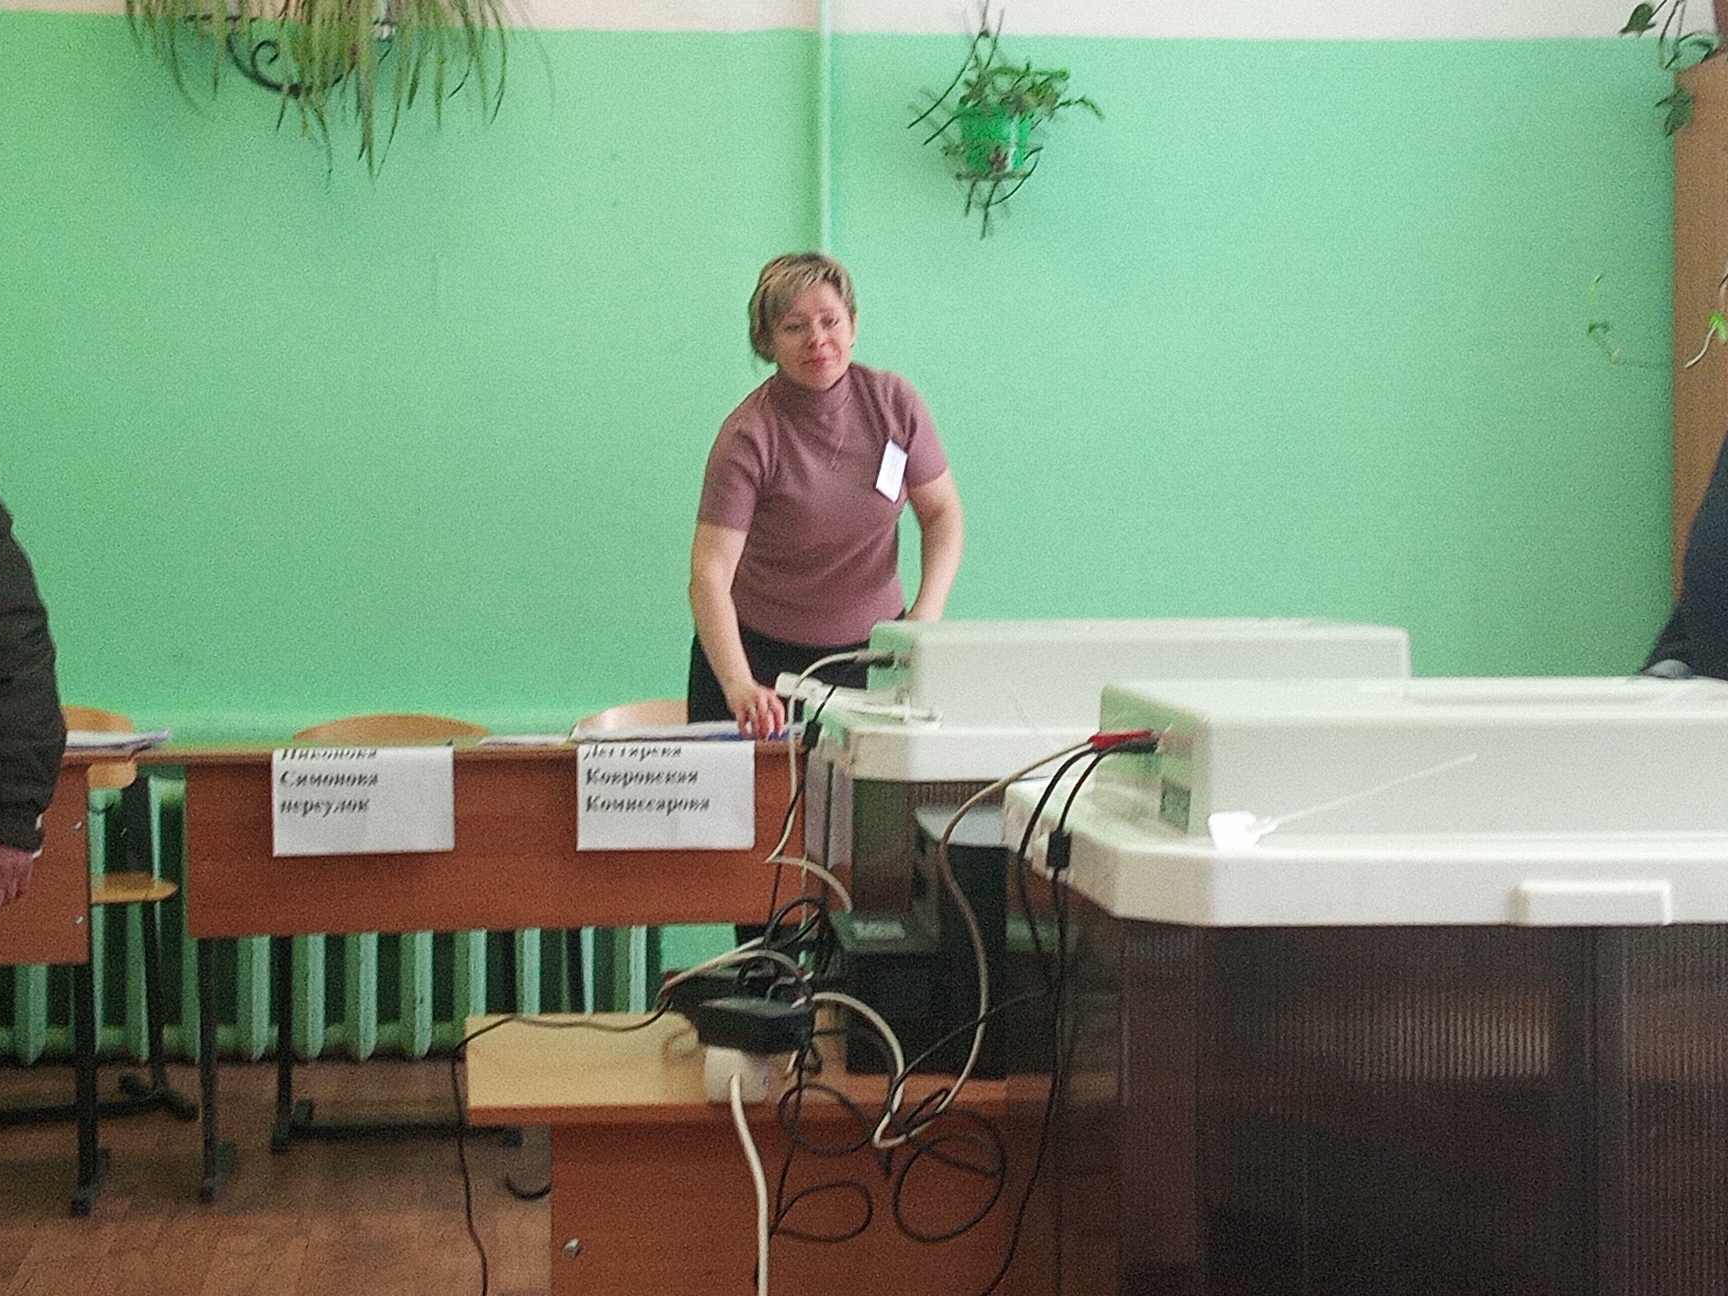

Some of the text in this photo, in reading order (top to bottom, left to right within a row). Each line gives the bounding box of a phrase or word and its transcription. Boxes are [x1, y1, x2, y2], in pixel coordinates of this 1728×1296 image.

[279, 770, 379, 788] Симонова
[279, 798, 371, 818] переулок
[584, 794, 711, 816] Комиссарова
